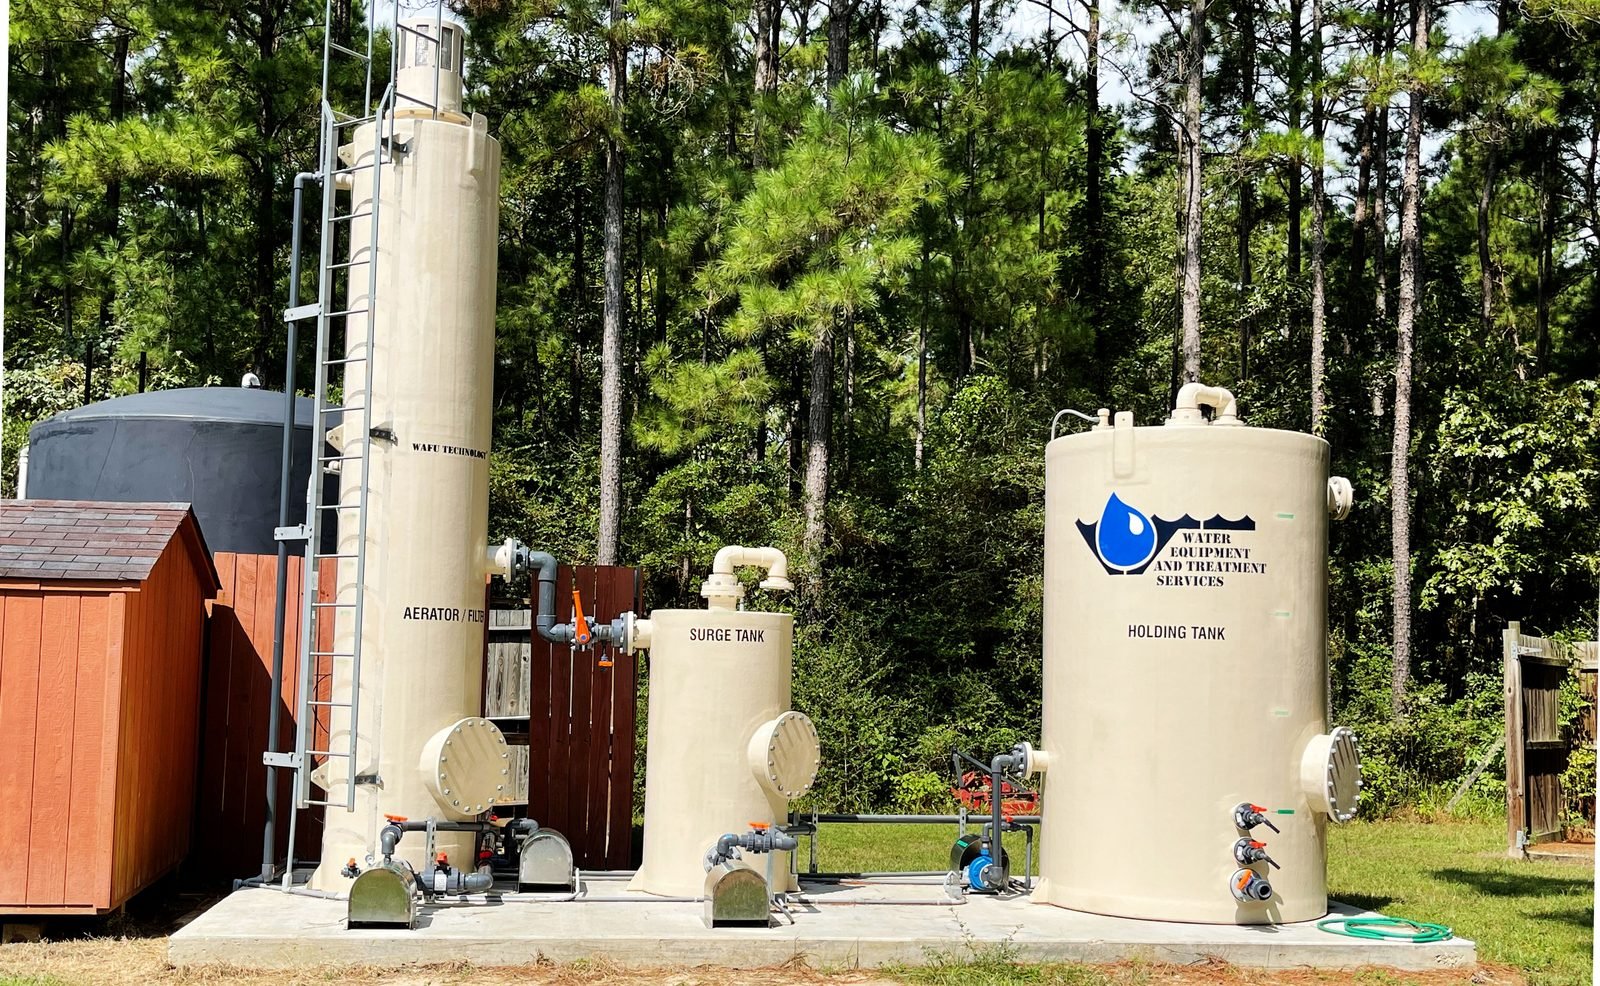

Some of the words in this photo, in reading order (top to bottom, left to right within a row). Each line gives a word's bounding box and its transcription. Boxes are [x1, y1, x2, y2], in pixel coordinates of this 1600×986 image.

[412, 443, 440, 453] WAFU
[1182, 532, 1231, 544] WATER
[1170, 546, 1251, 559] EQUIPMENT
[1153, 560, 1183, 572] AND
[1186, 561, 1267, 574] TREATMENT
[1156, 575, 1224, 587] SERVICES
[403, 606, 460, 621] AERATOR
[461, 608, 467, 623] /
[689, 627, 732, 641] SURGE
[735, 629, 765, 642] TANK
[1128, 624, 1187, 639] HOLDING
[1191, 626, 1226, 640] TANK
